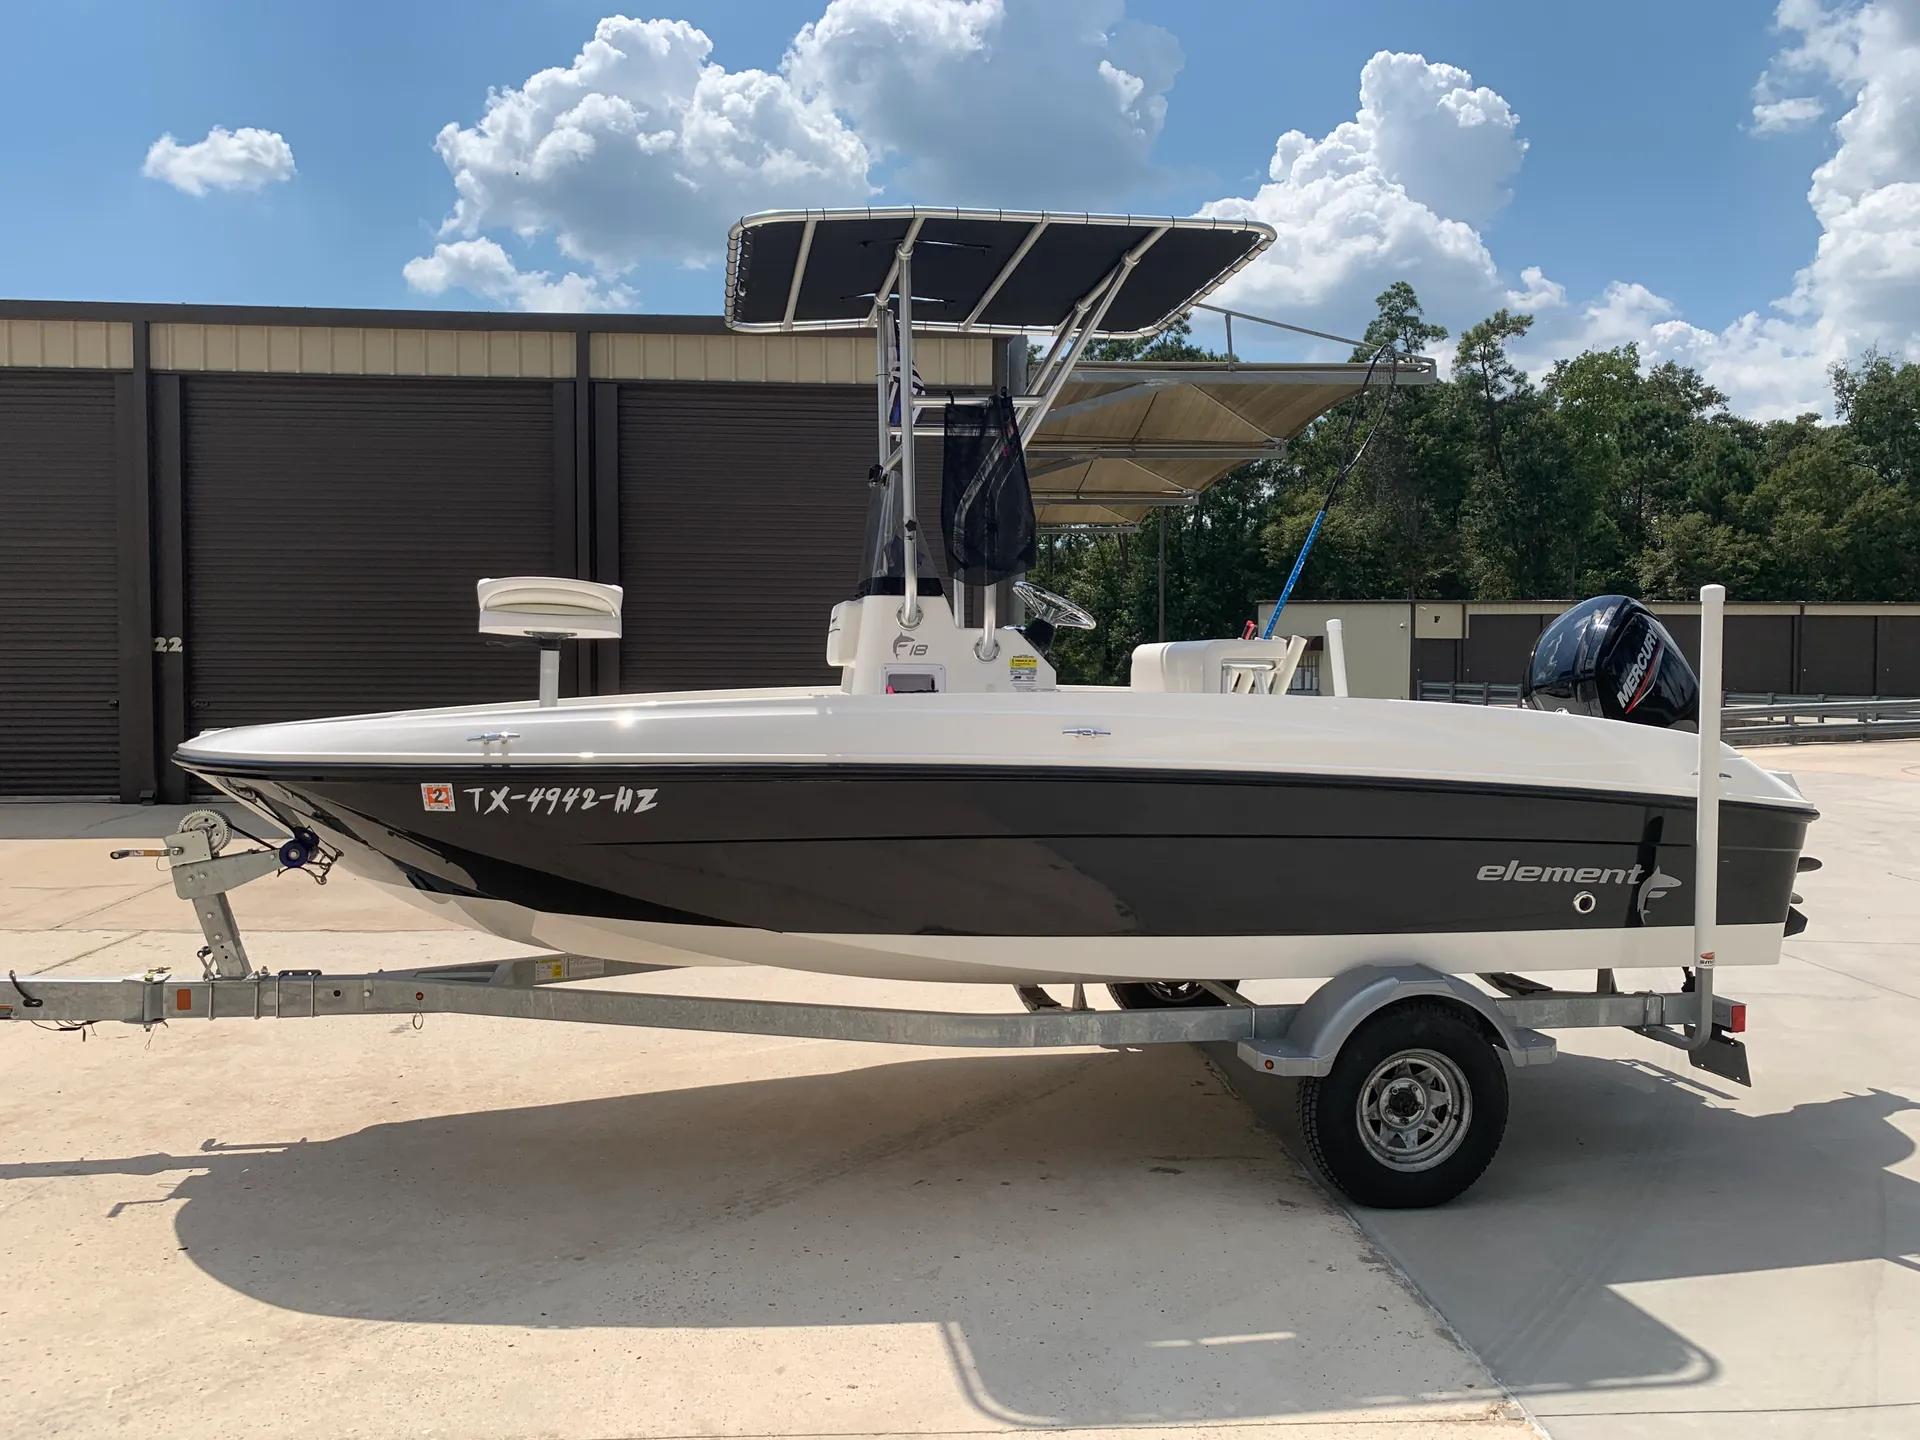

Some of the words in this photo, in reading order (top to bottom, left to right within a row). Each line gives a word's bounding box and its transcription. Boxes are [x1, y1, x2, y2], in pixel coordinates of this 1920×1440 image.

[1434, 615, 1441, 623] F
[154, 636, 184, 653] 22
[1616, 623, 1658, 709] MERCURY
[463, 786, 659, 815] TX-4942-HZ
[1476, 859, 1645, 885] element
